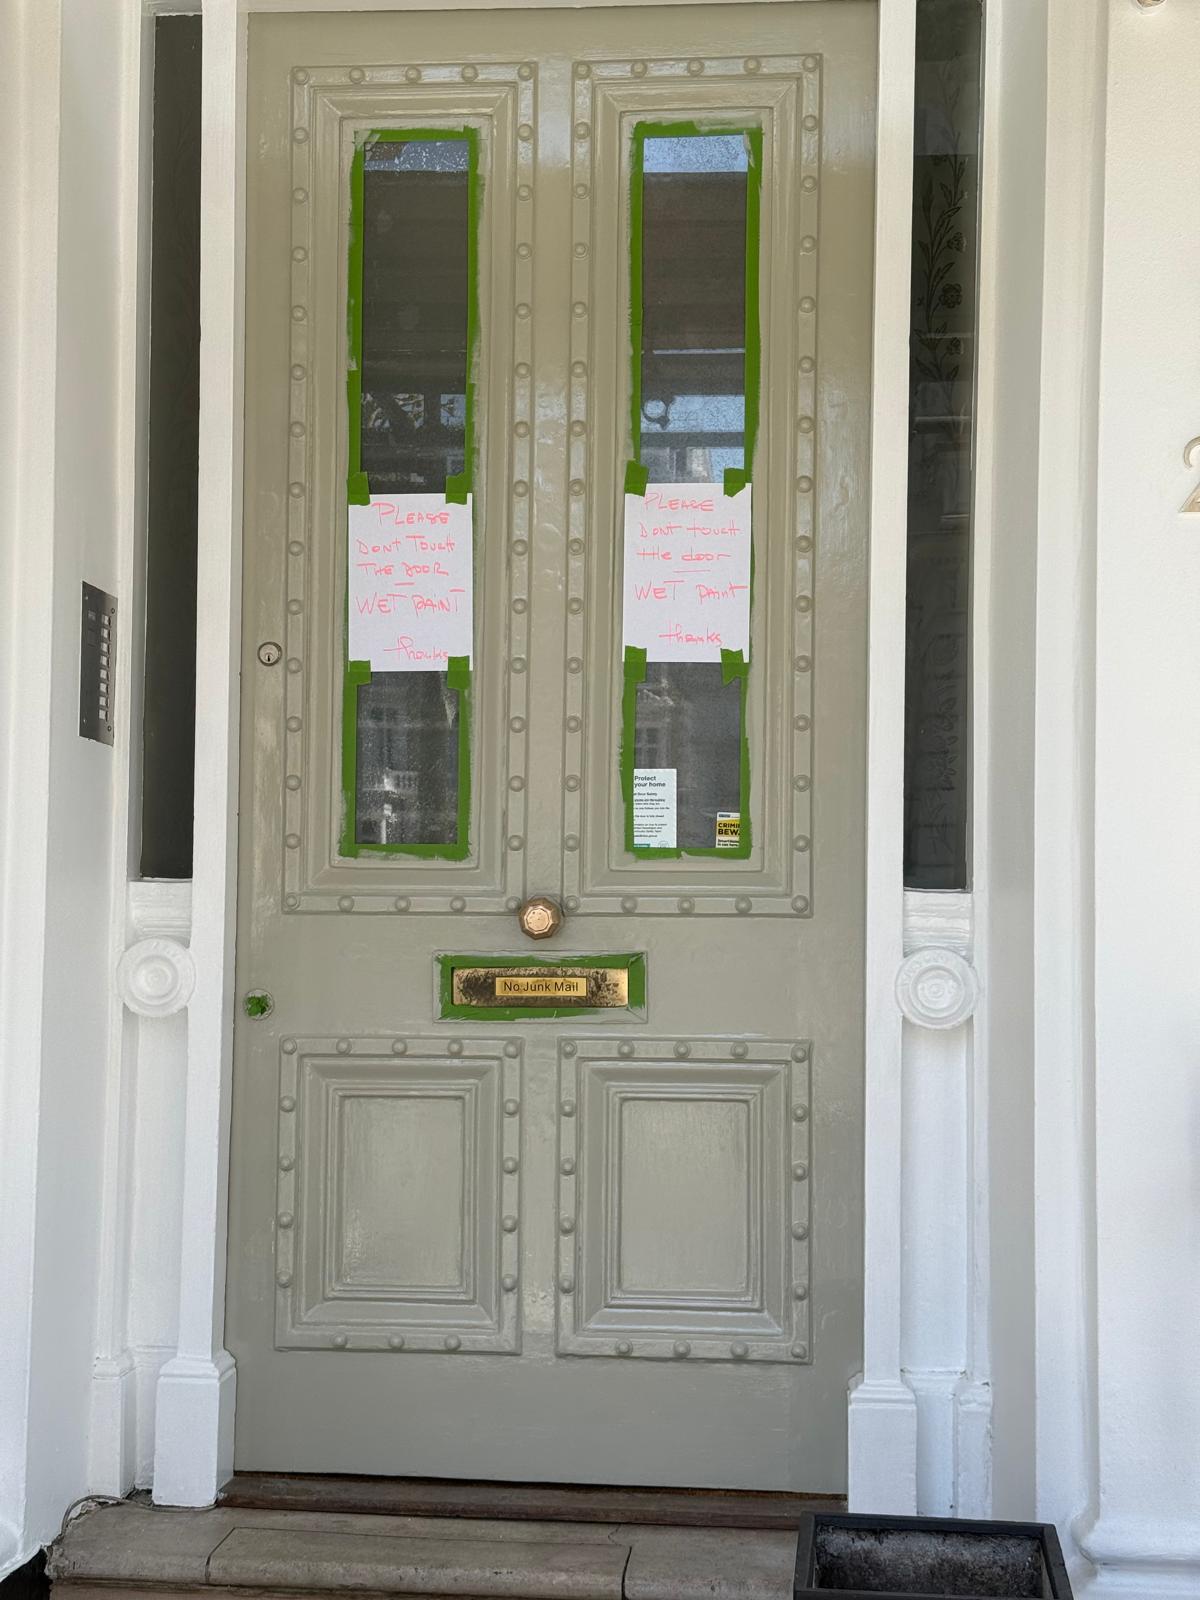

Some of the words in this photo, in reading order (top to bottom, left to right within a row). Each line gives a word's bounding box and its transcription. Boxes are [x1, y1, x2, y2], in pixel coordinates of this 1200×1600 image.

[644, 492, 715, 512] PLEASE
[371, 502, 450, 527] PLEASE
[635, 580, 685, 601] WET
[355, 592, 407, 615] WET
[503, 982, 519, 992] No
[523, 982, 551, 992] Junk
[555, 982, 578, 992] Mail
